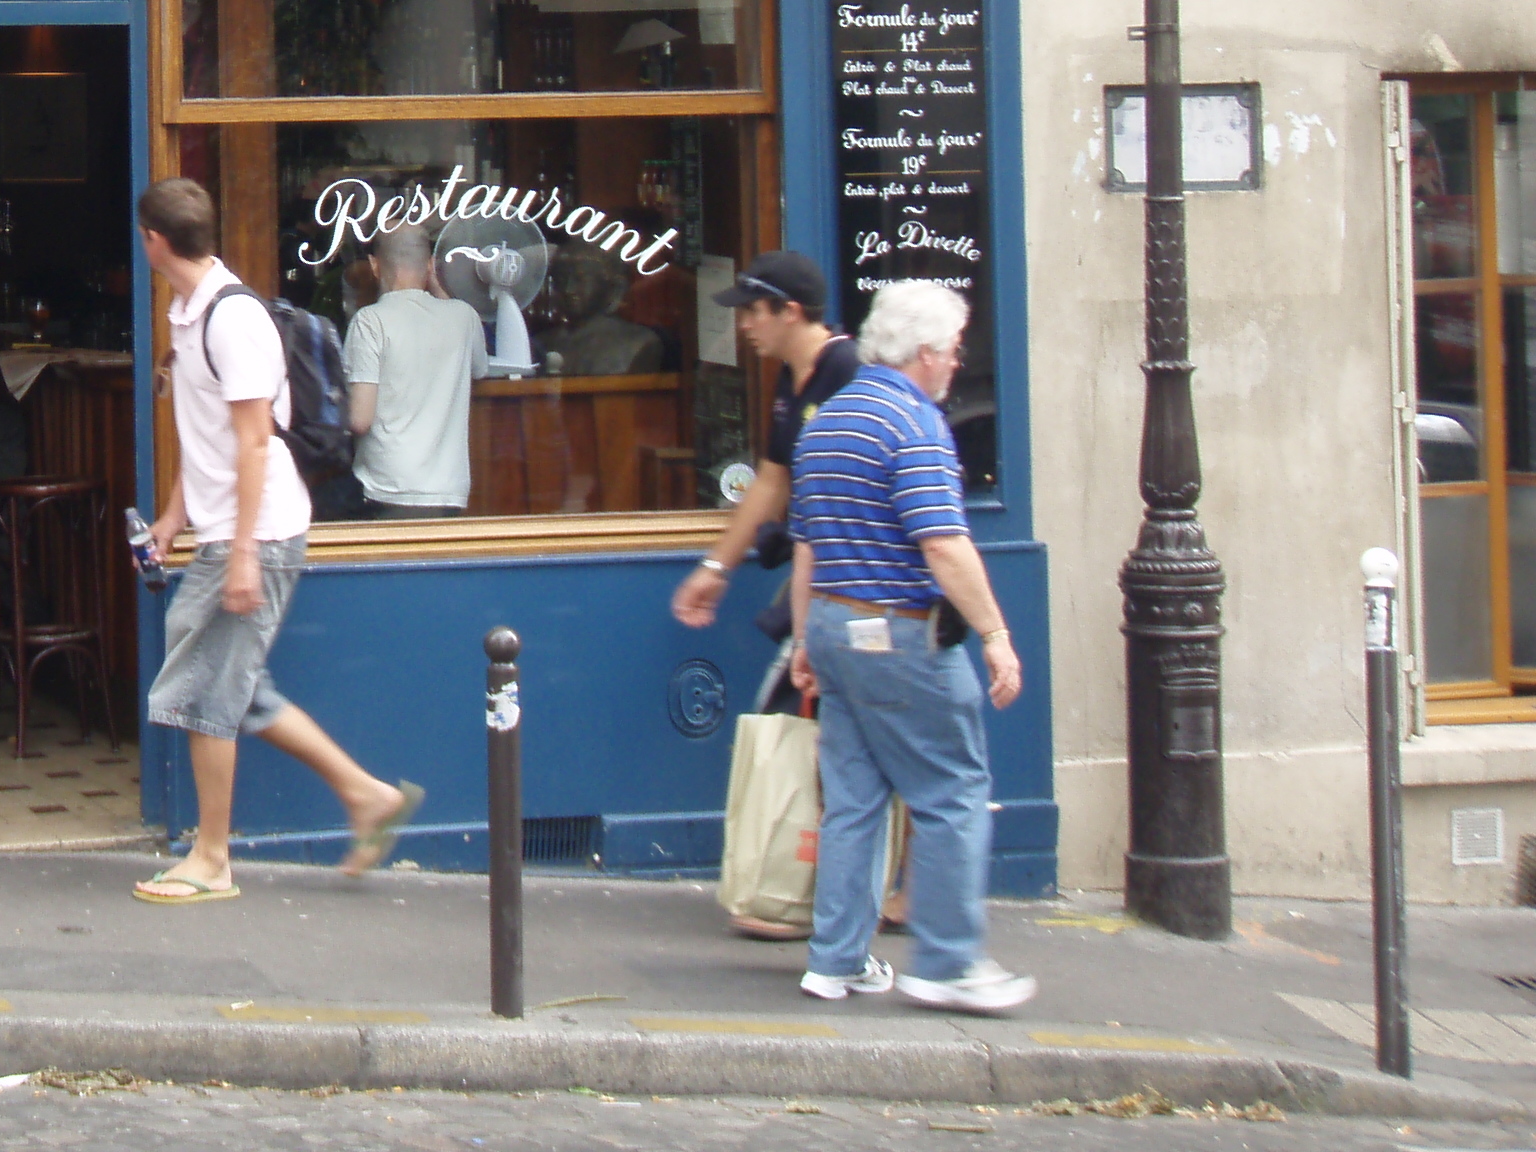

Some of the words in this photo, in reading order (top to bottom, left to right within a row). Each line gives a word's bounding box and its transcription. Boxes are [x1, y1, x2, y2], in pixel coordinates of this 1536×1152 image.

[838, 4, 917, 27] Formule
[920, 12, 937, 26] du
[939, 8, 980, 35] jour
[900, 30, 926, 52] 14€
[842, 128, 913, 149] Formule
[917, 133, 934, 147] du
[937, 129, 983, 155] jour
[901, 154, 927, 175] 19€
[298, 164, 679, 275] Restaurant
[855, 231, 892, 265] La
[897, 221, 982, 261] Divette
